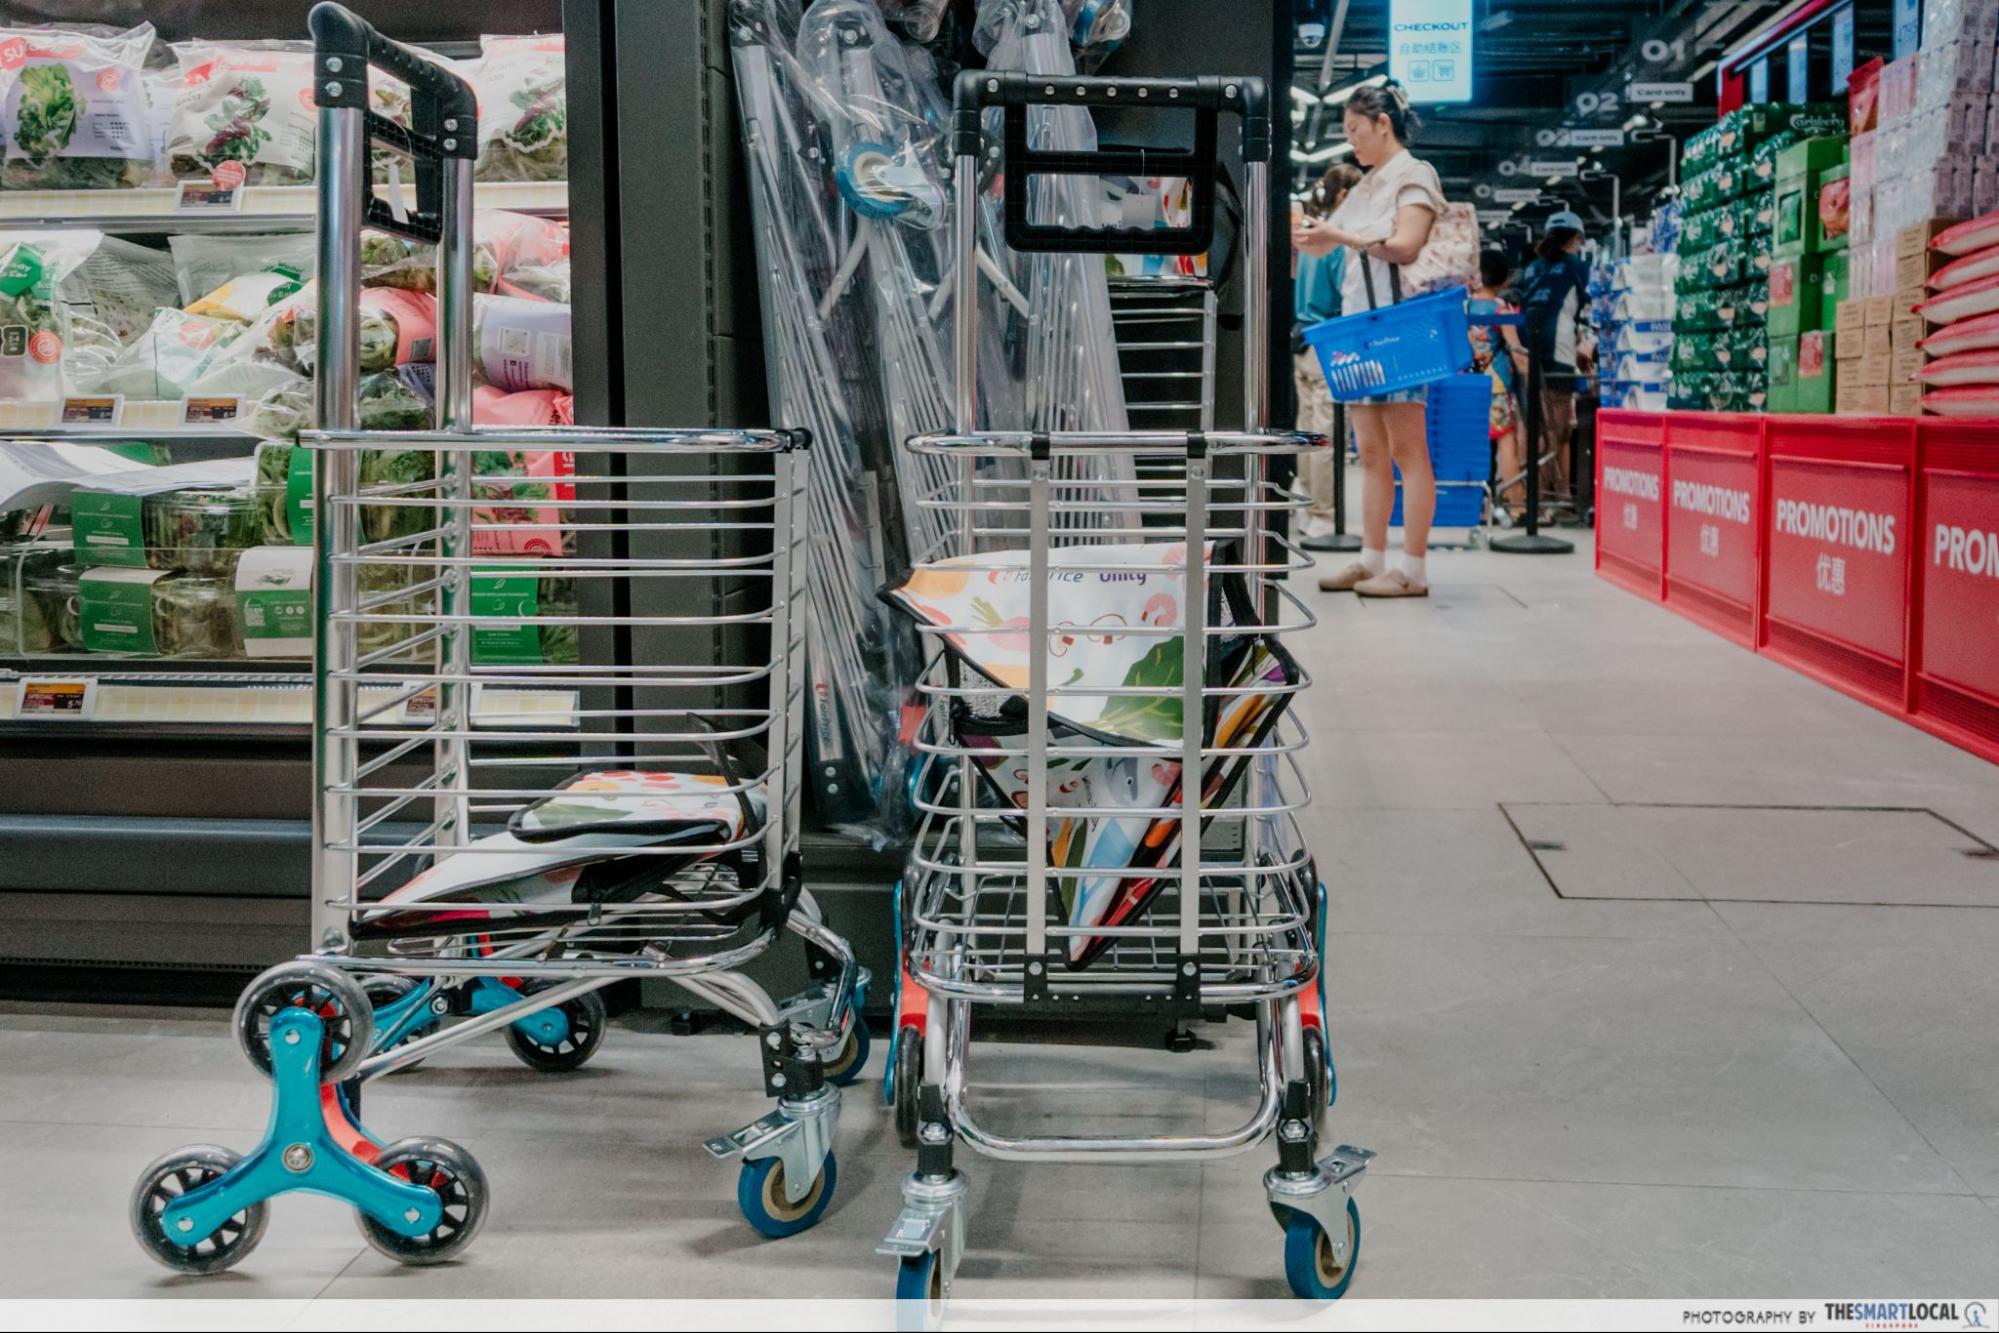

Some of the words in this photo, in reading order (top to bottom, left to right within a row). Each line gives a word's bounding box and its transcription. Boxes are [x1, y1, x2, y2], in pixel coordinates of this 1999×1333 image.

[1394, 22, 1469, 32] CHECKOUT
[1641, 39, 1686, 62] 01
[1575, 91, 1619, 112] 02
[1637, 88, 1662, 97] Card
[1664, 88, 1686, 97] only
[1790, 113, 1845, 130] Carlsberg
[1603, 466, 1660, 503] PROMOTIONS
[1673, 479, 1750, 525] PROMOTIONS
[1776, 498, 1896, 556] PROMOTIONS
[1816, 552, 1846, 596] 优惠
